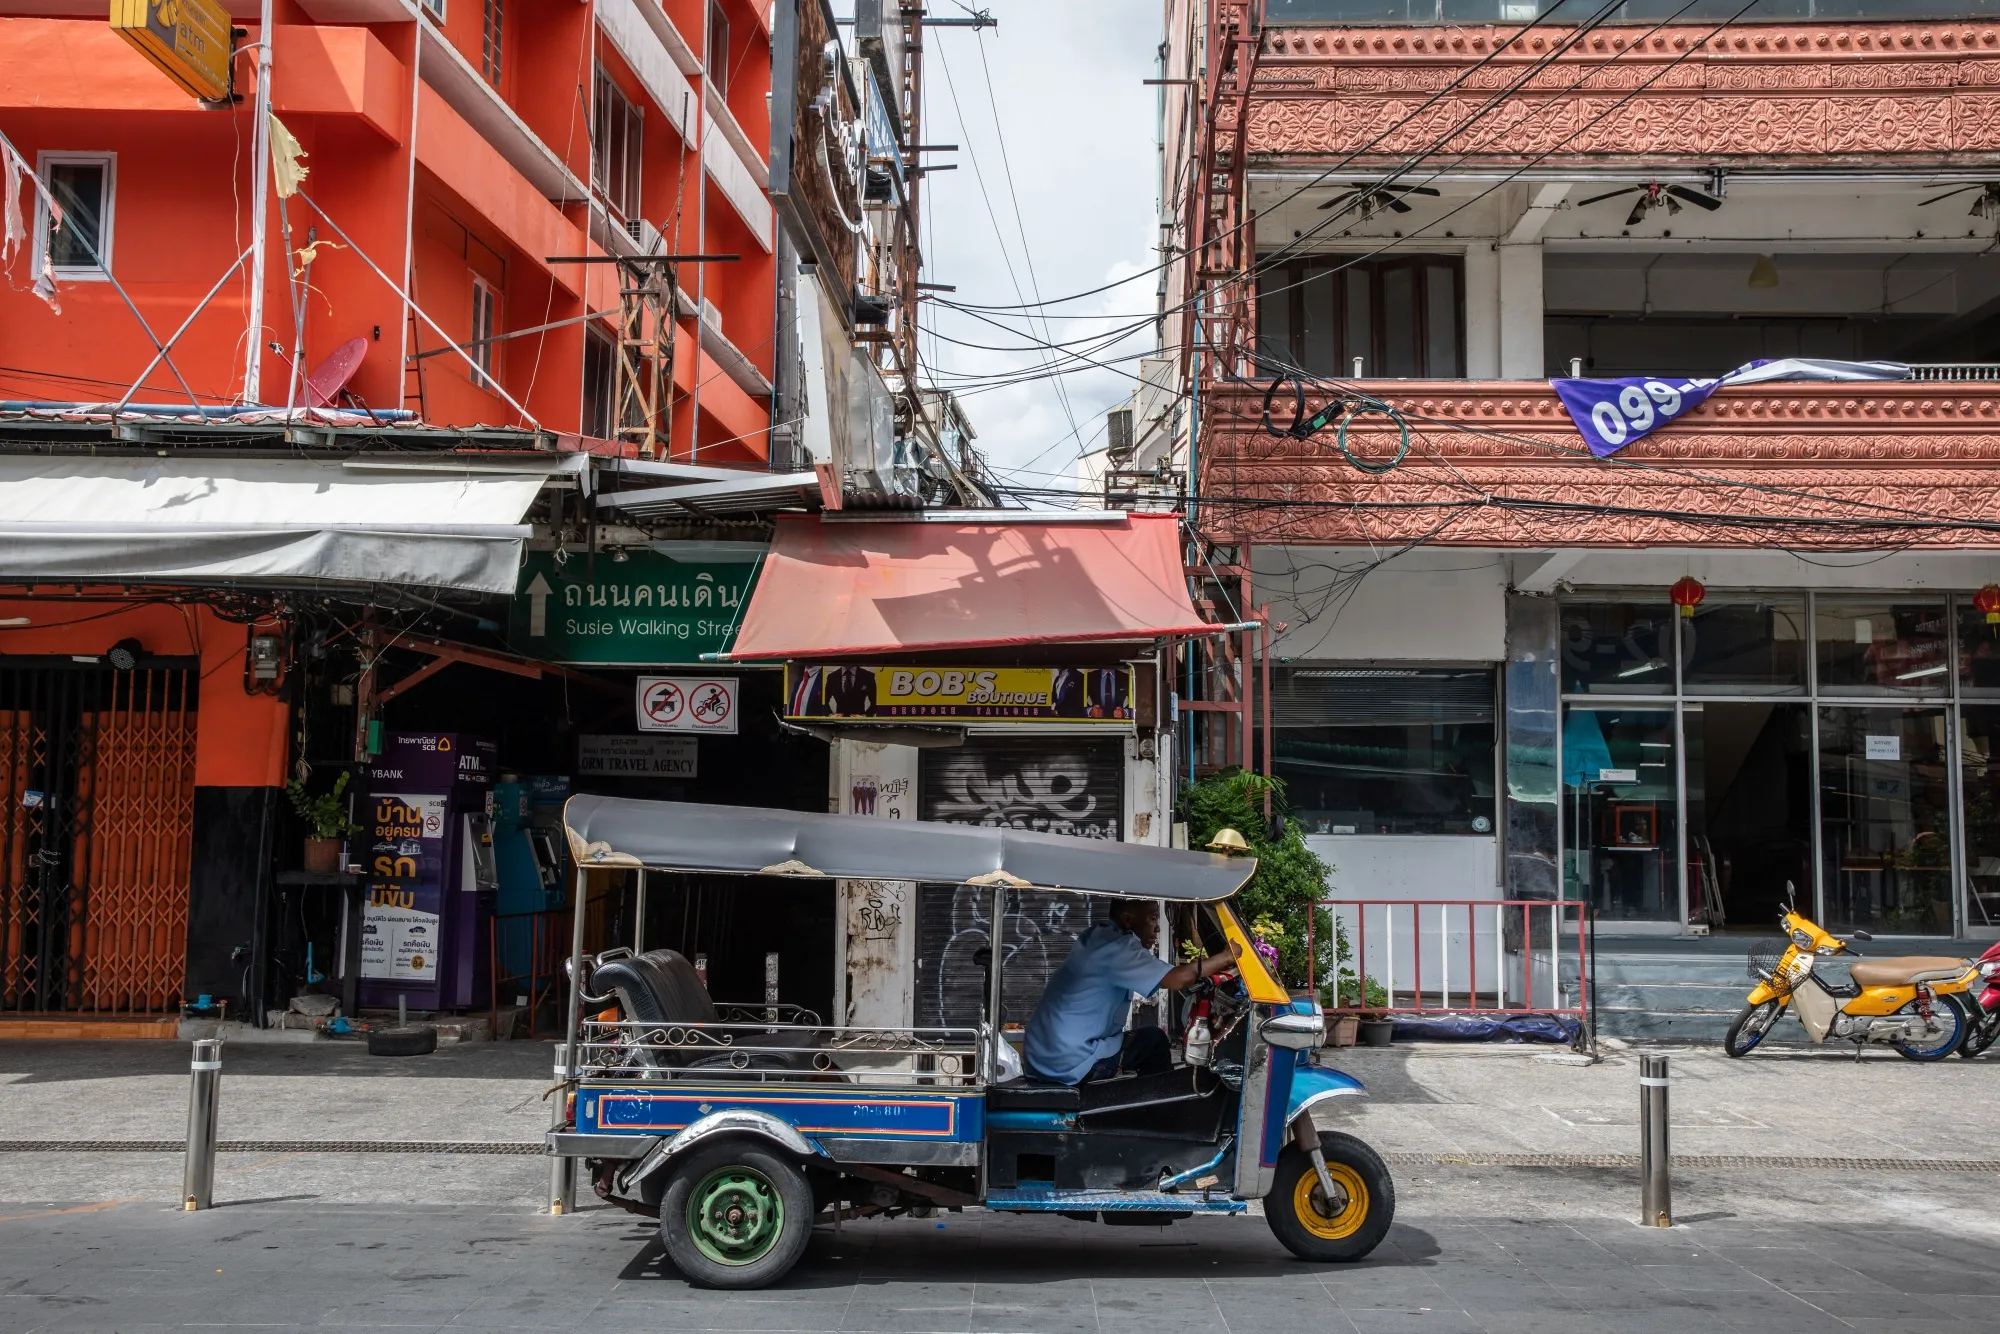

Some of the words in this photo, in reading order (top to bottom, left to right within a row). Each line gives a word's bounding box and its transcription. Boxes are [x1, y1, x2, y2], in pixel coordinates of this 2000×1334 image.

[180, 22, 205, 55] atm
[564, 572, 738, 608] ถนนคนเดิน
[566, 619, 613, 636] Susie
[619, 619, 689, 639] Walking
[889, 671, 998, 696] BOB'S
[966, 691, 1047, 705] BOUTIQUE
[892, 706, 956, 716] BESPOKE
[977, 707, 1039, 716] TAILORS
[398, 735, 437, 745] ไทยพาณิชย์
[459, 754, 480, 771] ATM
[582, 757, 604, 771] ORM
[607, 758, 649, 772] TRAVEL
[653, 759, 694, 773] AGENCY
[376, 797, 421, 825] บ้าน
[375, 820, 421, 843] อยู่ครบ
[370, 884, 415, 909] มีขับ
